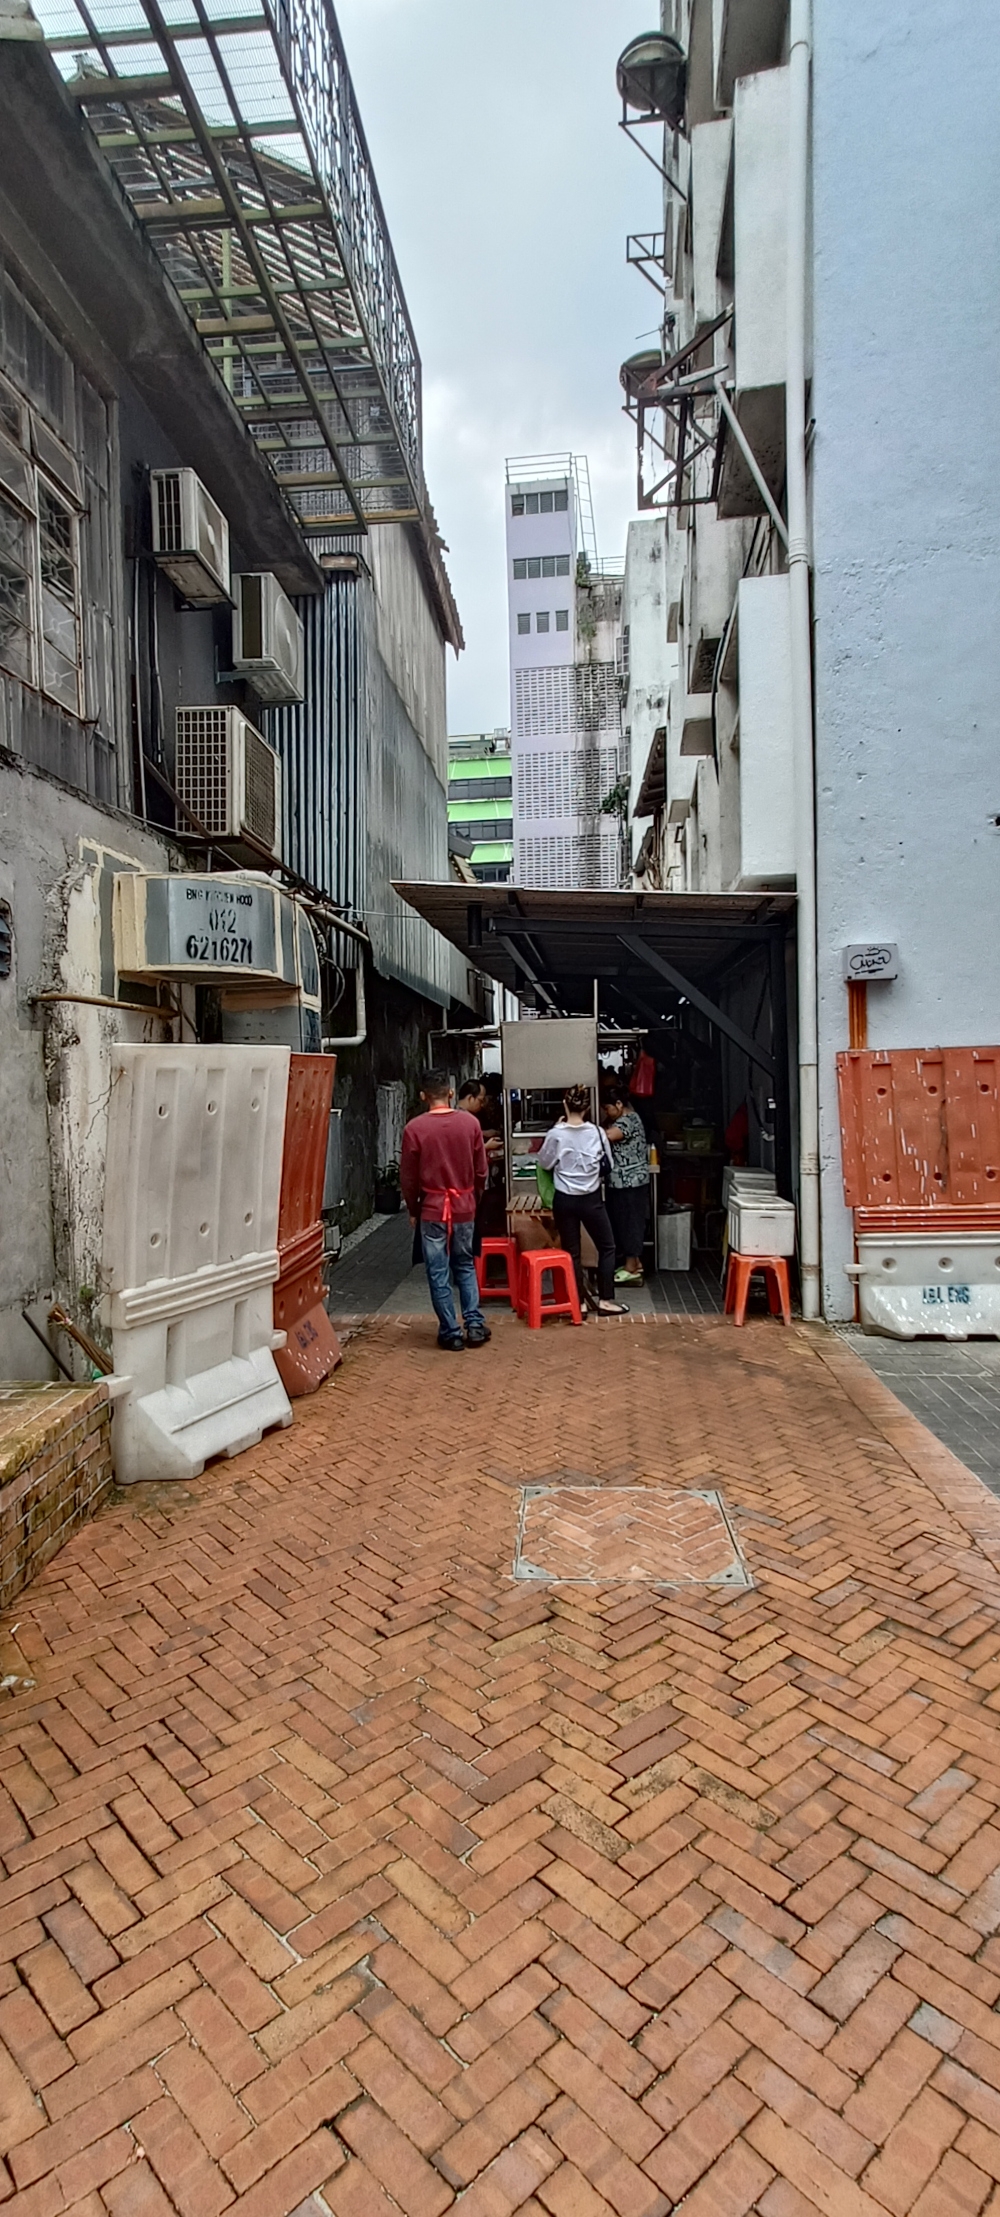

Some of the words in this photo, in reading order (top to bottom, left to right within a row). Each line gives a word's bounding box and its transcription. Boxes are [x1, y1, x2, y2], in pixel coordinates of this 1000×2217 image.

[236, 894, 253, 907] HOOD
[209, 909, 237, 934] 012
[186, 935, 253, 964] 6216271
